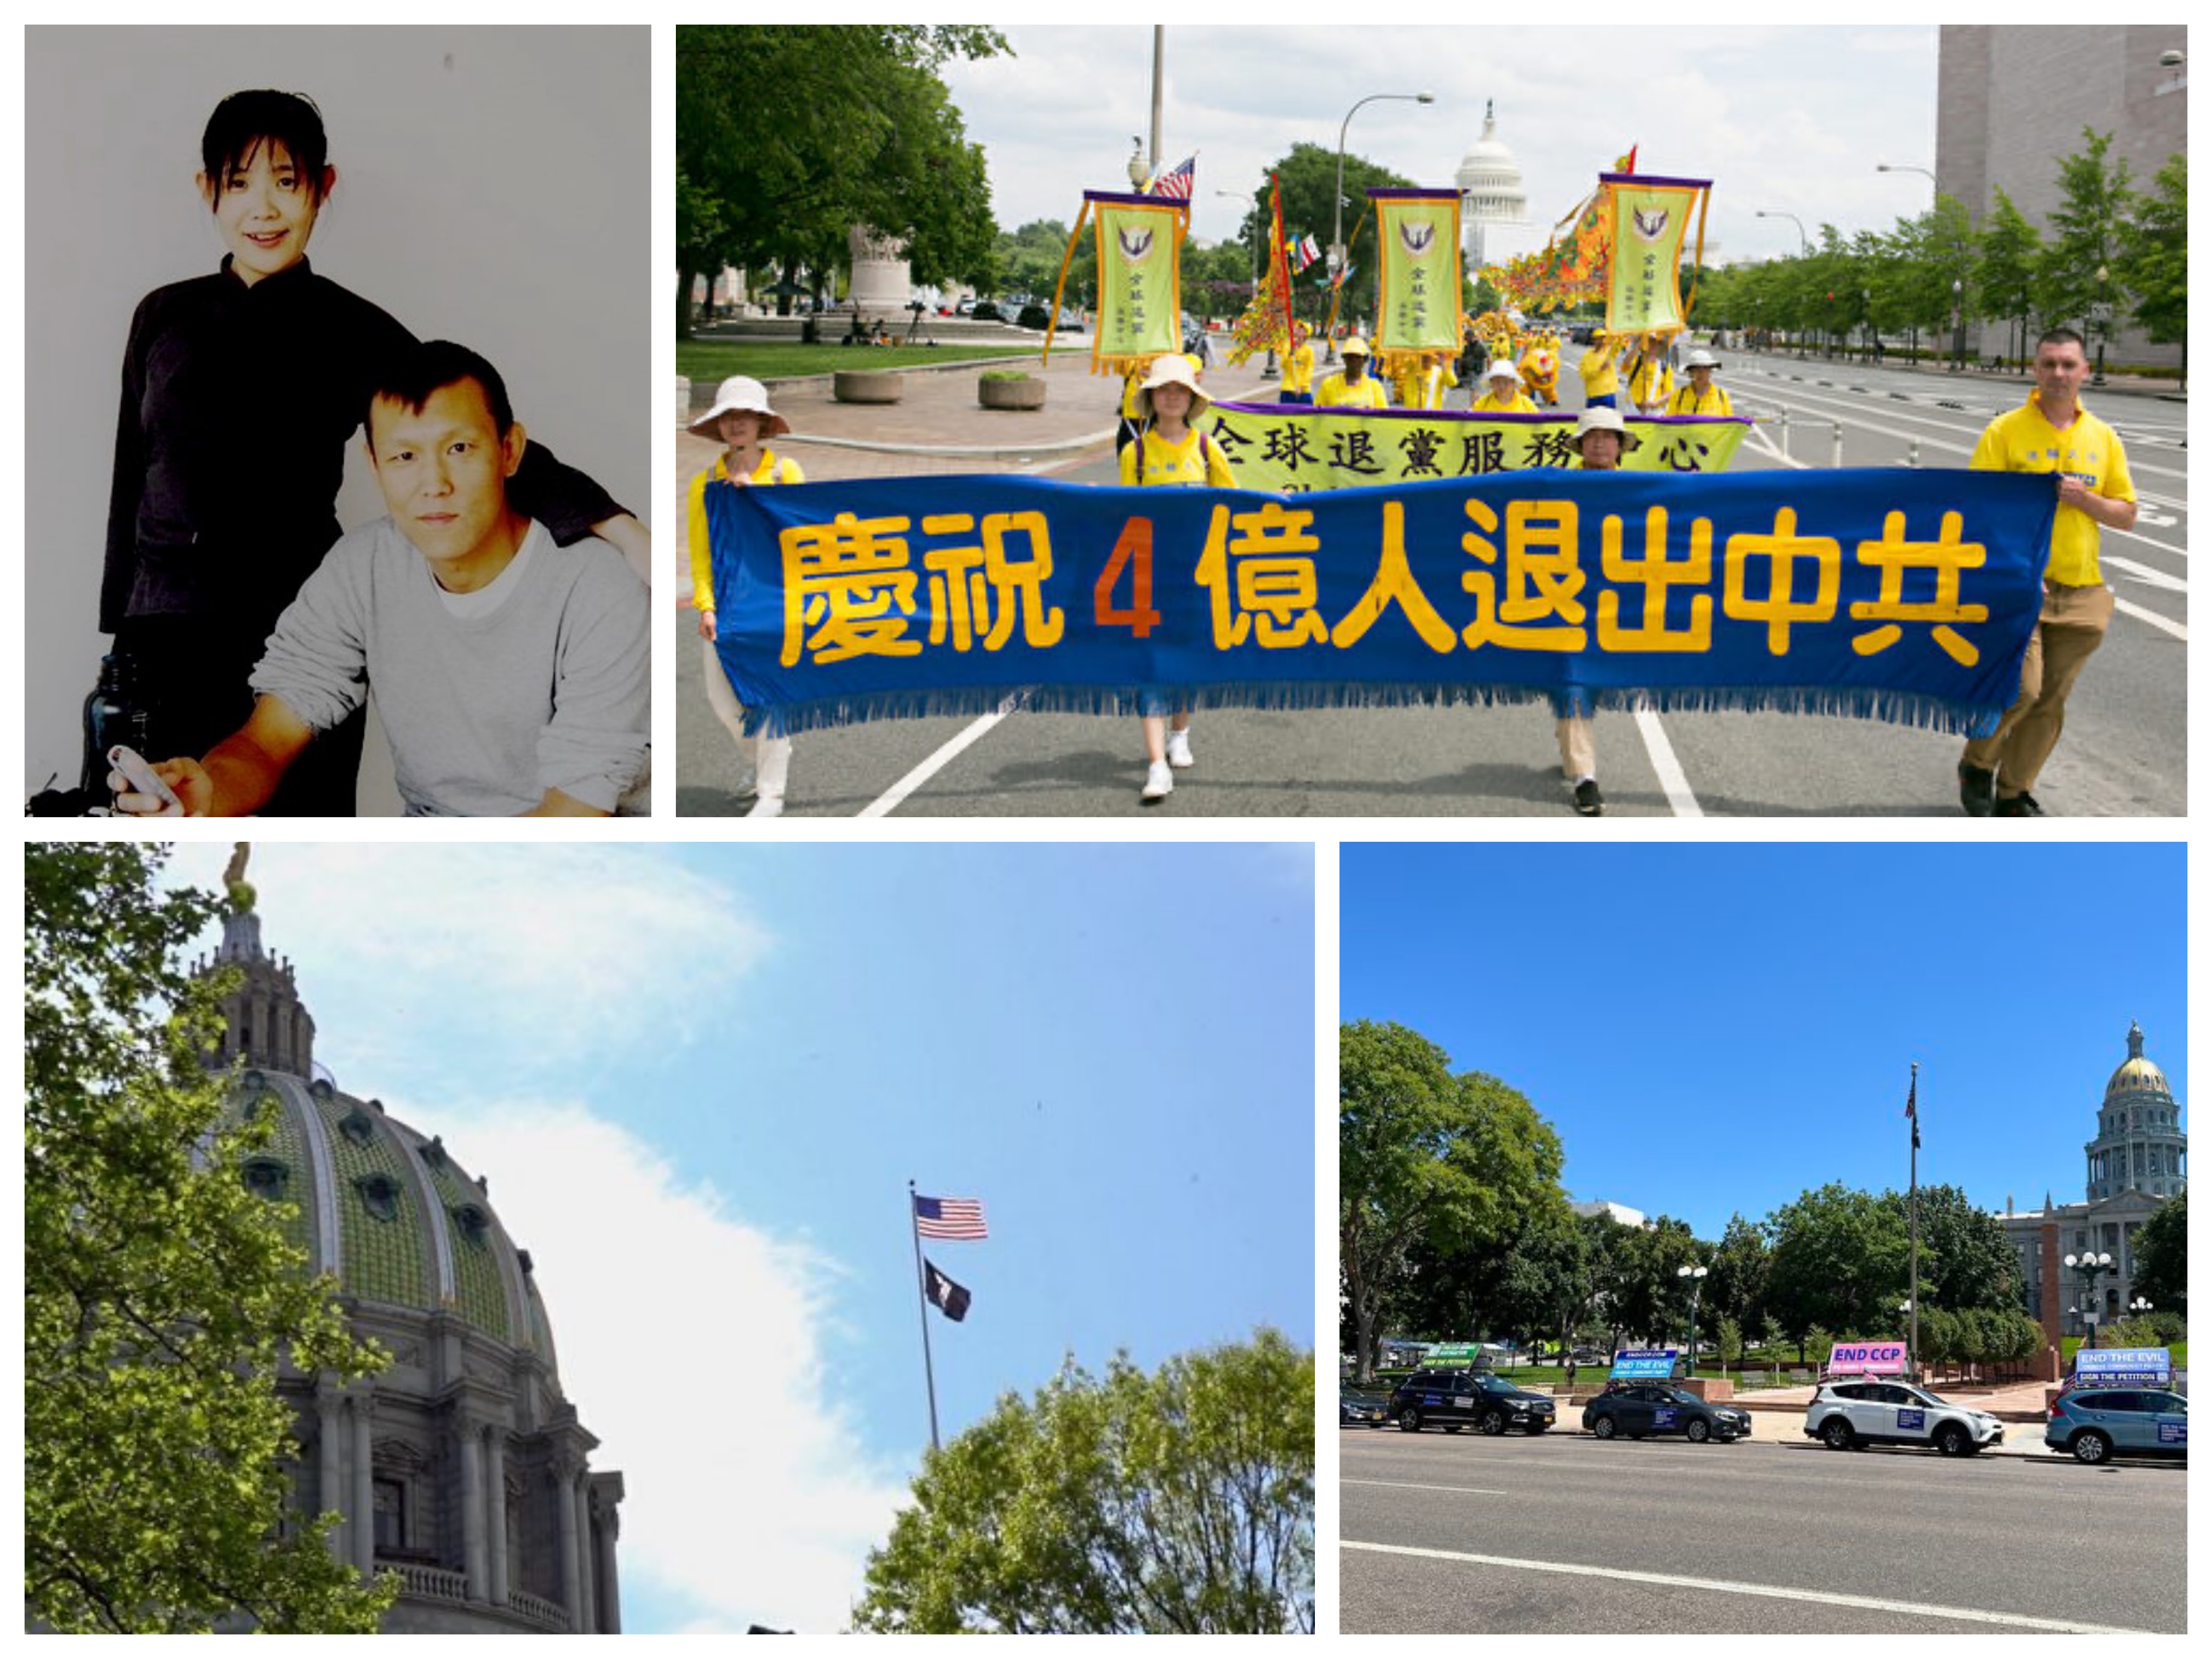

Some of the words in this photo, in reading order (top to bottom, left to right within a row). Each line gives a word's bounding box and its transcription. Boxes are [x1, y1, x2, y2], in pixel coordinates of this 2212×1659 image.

[1210, 416, 1709, 476] 全球退黨服務心
[1835, 1349, 1867, 1360] END
[1870, 1349, 1900, 1360] CCP
[2081, 1354, 2107, 1362] END
[2111, 1353, 2134, 1362] THE
[2138, 1352, 2165, 1362] EVIL
[1616, 1360, 1635, 1369] END
[1636, 1360, 1652, 1369] THE
[1653, 1360, 1671, 1369] EVIL
